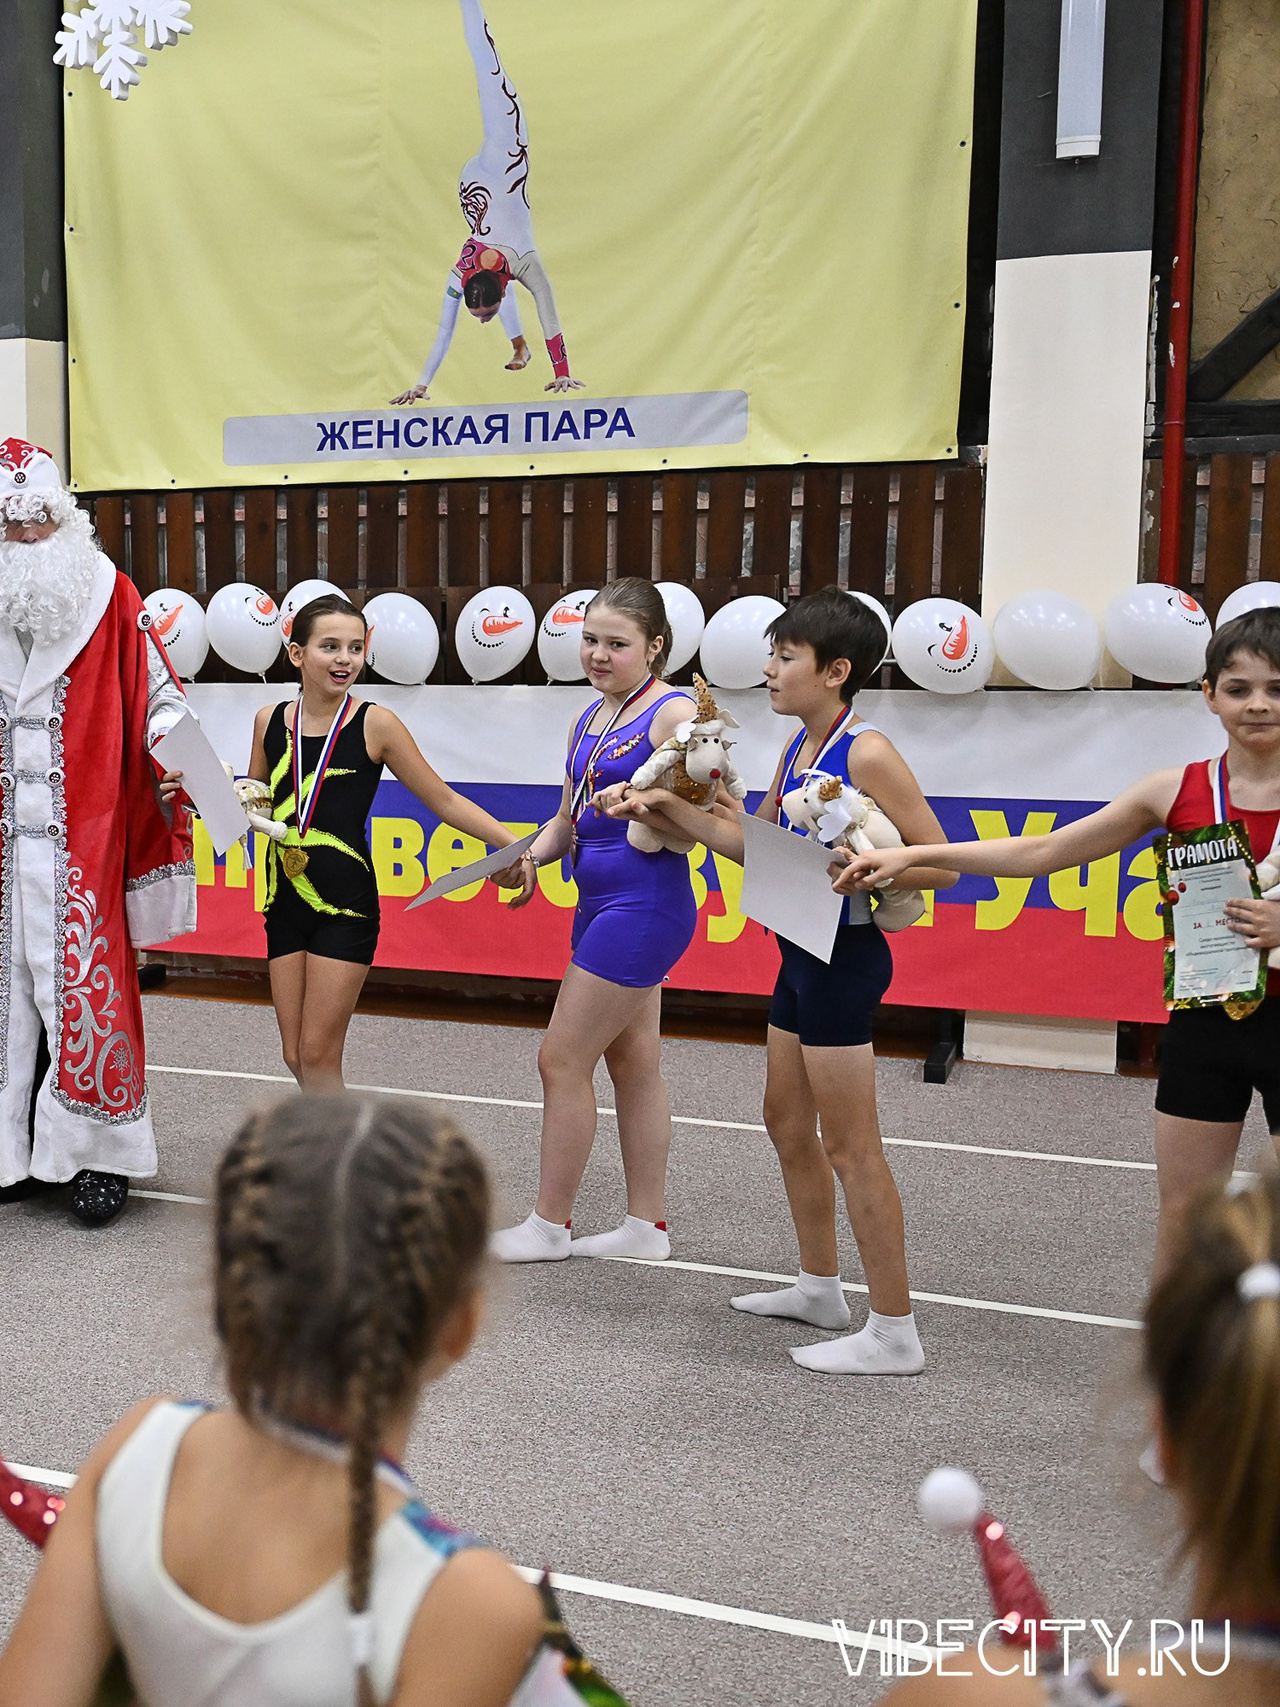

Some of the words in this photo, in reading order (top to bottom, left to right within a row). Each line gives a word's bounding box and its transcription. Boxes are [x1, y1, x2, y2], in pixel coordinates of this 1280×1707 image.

[316, 413, 509, 451] ЖЕНСКАЯ
[524, 407, 636, 443] ПАРА
[1167, 838, 1238, 868] ГРАМОТА
